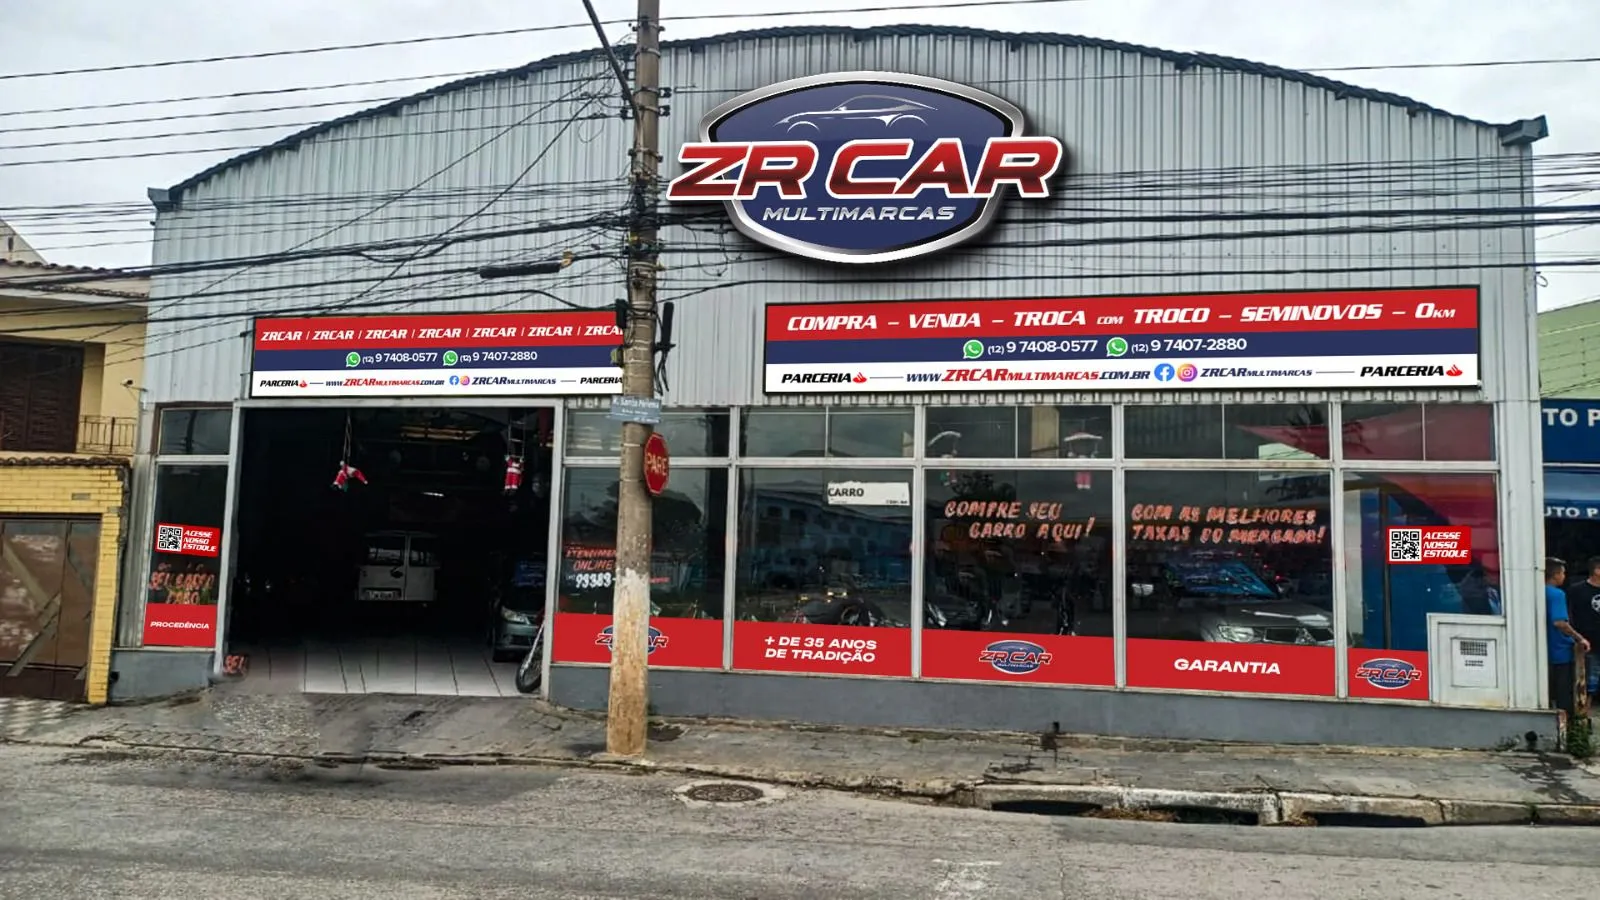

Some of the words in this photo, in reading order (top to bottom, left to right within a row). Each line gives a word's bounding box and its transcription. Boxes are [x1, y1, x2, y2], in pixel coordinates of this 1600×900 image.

[667, 139, 819, 200] ZR
[825, 136, 1063, 199] CAR
[762, 206, 957, 221] MULTIMARCAS
[787, 315, 877, 331] COMPRA
[909, 312, 981, 328] VENDA
[1014, 310, 1086, 327] TROCA
[1097, 316, 1123, 324] COM
[1134, 308, 1210, 324] TROCO
[1240, 304, 1383, 322] SEMINOVOS
[260, 330, 303, 341] ZRCAR
[312, 329, 355, 340] ZRCAR
[364, 328, 408, 340] ZRCAR
[418, 328, 461, 339] ZRCAR
[472, 327, 517, 338] ZRCAR
[527, 326, 573, 337] ZRCAR
[988, 345, 1004, 355] (12)
[1019, 340, 1098, 353] 7408-0577
[1131, 343, 1149, 354] (12)
[1163, 338, 1247, 351] 7407-2880
[362, 356, 374, 364] (12)
[459, 354, 472, 362] (12)
[483, 351, 538, 361] 7407-2880
[782, 373, 852, 384] PARCERIA
[1360, 365, 1445, 378] PARCERIA
[646, 452, 668, 476] PARE
[828, 488, 864, 497] CARRO
[945, 500, 1022, 518] COMPRE
[1131, 504, 1172, 521] COM
[1179, 505, 1200, 522] AS
[1206, 507, 1316, 524] MELHORES
[184, 530, 212, 538] ACESSE
[969, 522, 1027, 539] CARRO
[1133, 524, 1191, 542] TAXAS
[183, 537, 209, 545] NOSSO
[183, 543, 217, 552] ESTOQUE
[1423, 541, 1457, 549] NOSSO
[1423, 550, 1469, 558] ESTOQUE
[150, 621, 210, 630] PROCEDÊNCIA
[778, 636, 801, 646] DE
[803, 637, 825, 647] 35
[828, 639, 877, 650] ANOS
[765, 648, 787, 658] DE
[792, 648, 876, 664] TRADIÇÃO
[1173, 658, 1280, 675] GARANTIA
